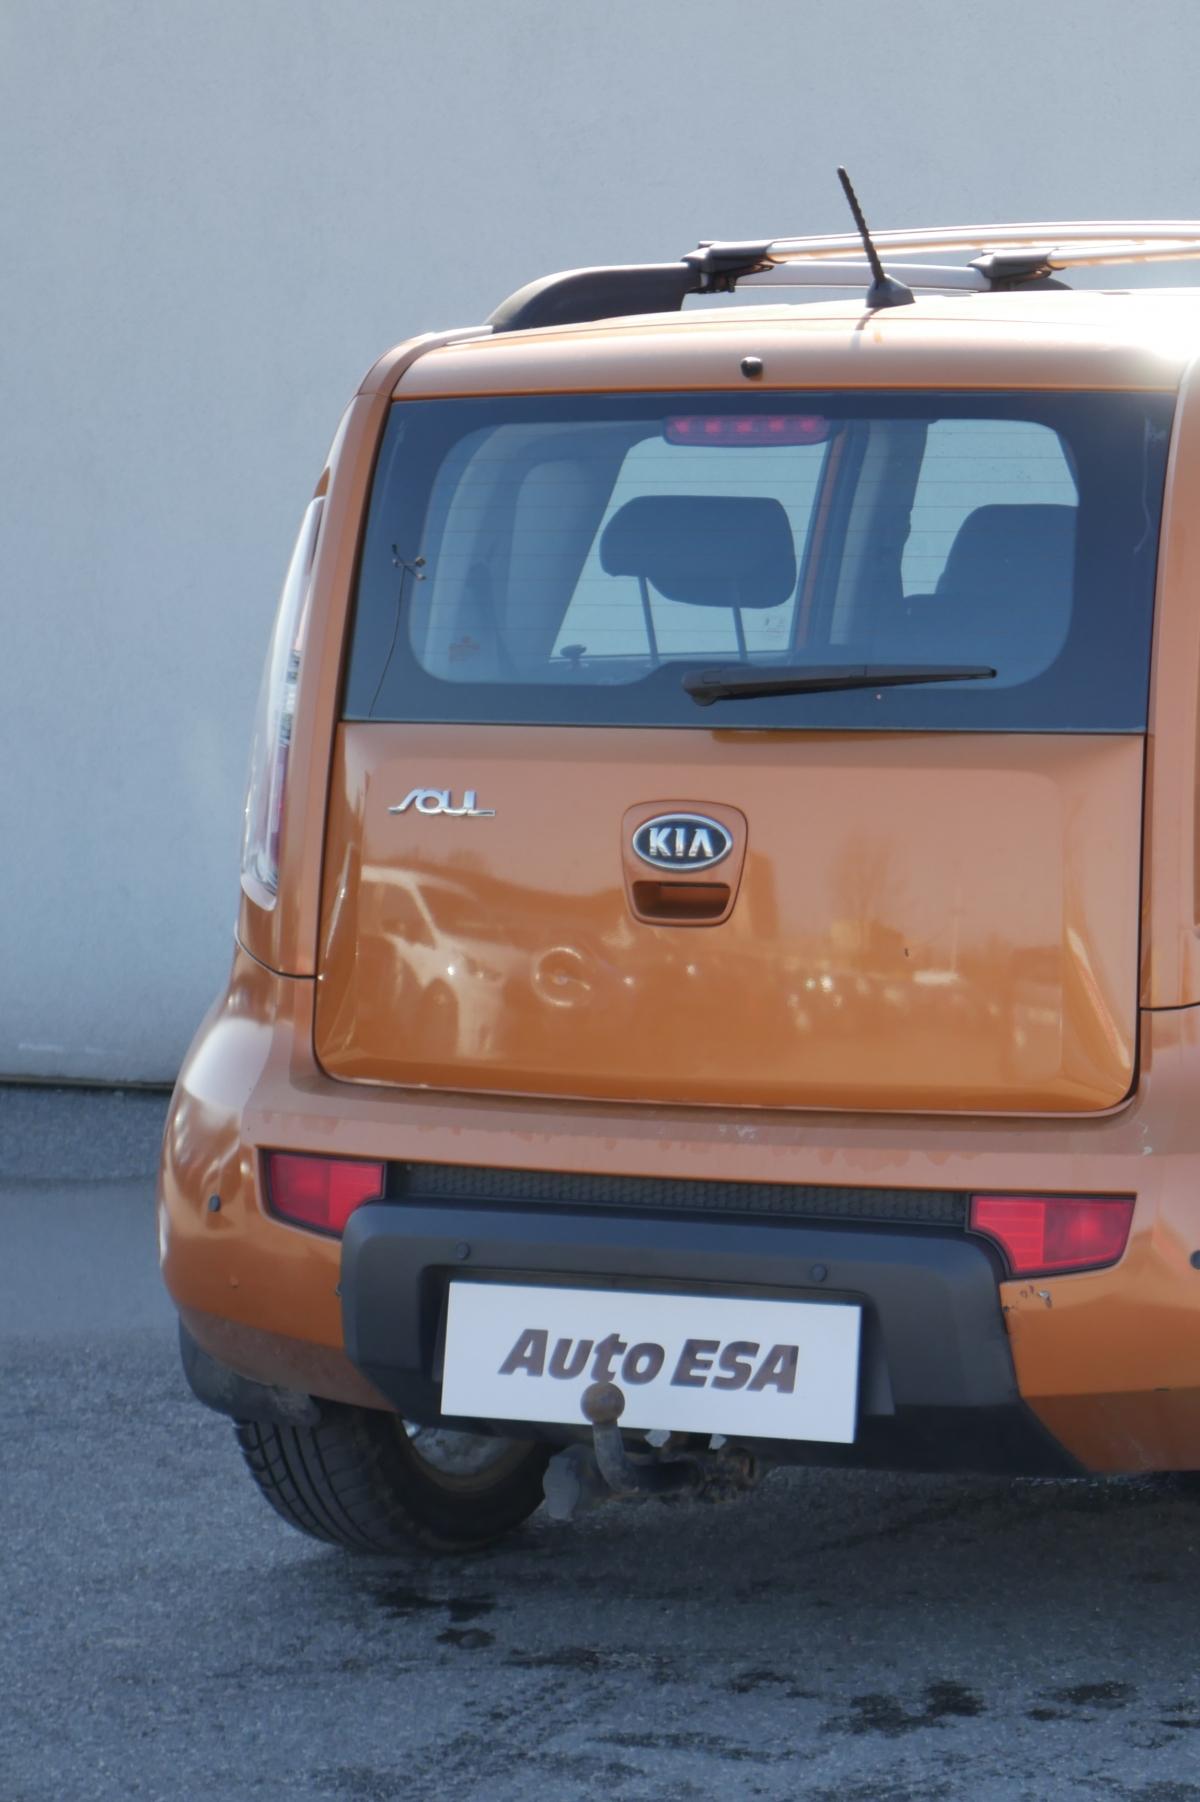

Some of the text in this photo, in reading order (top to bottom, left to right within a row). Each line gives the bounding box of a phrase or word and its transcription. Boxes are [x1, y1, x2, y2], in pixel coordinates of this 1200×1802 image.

[648, 826, 714, 858] KIA
[498, 1328, 799, 1394] Auto ESA
